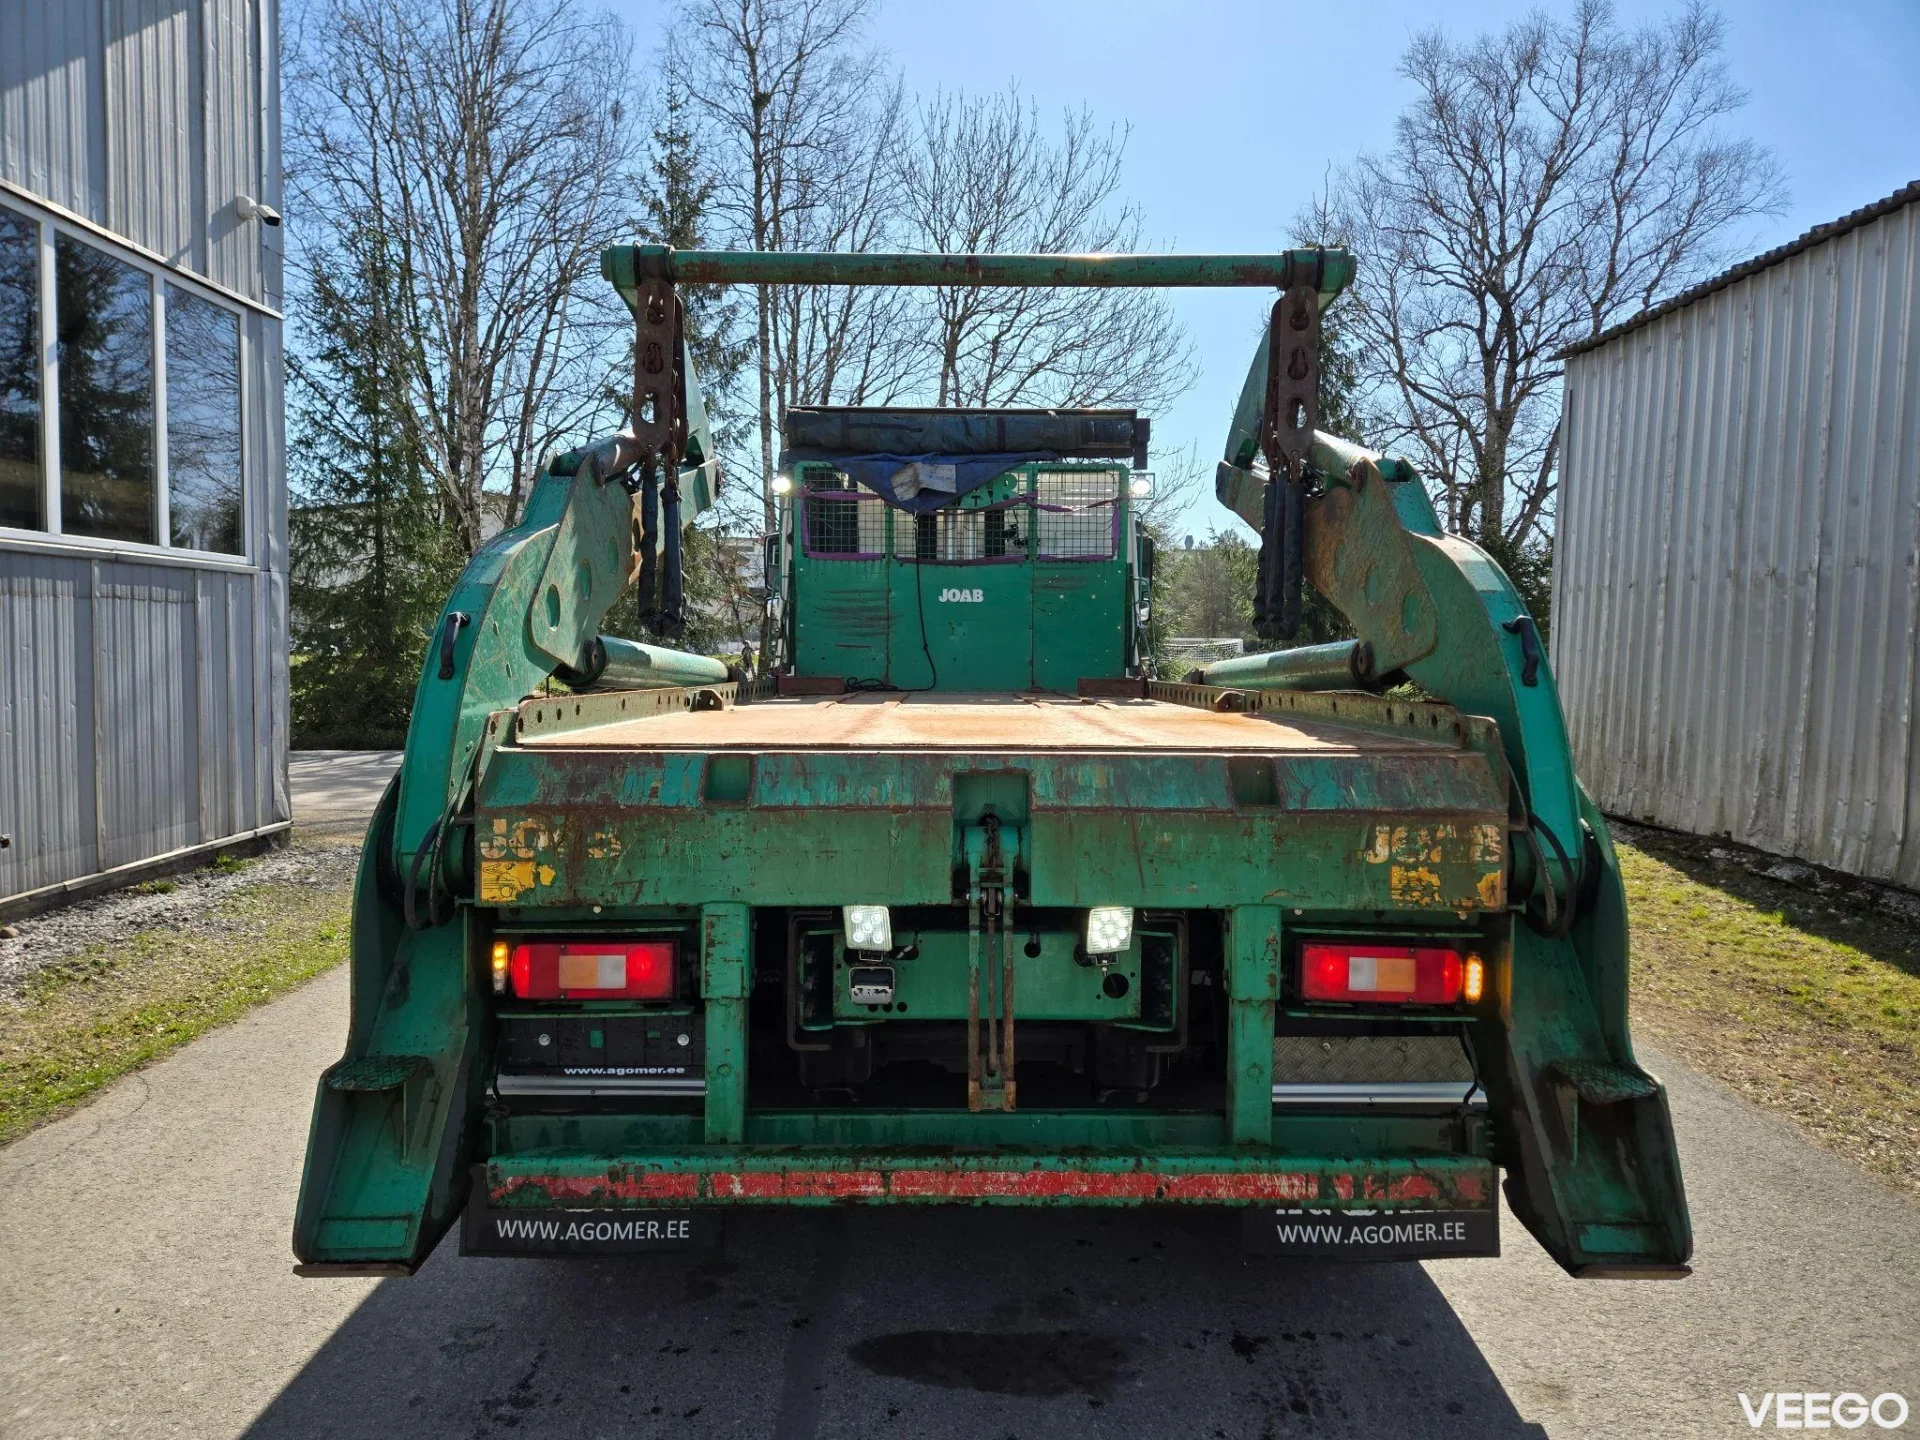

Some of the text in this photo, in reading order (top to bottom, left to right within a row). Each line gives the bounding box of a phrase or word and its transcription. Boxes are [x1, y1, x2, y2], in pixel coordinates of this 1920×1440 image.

[938, 588, 984, 603] JOAB
[564, 1066, 686, 1076] www.agomer.ee
[496, 1219, 691, 1241] WWW.AGOMER.EE
[1276, 1222, 1466, 1244] WWW.AGOMER.EE
